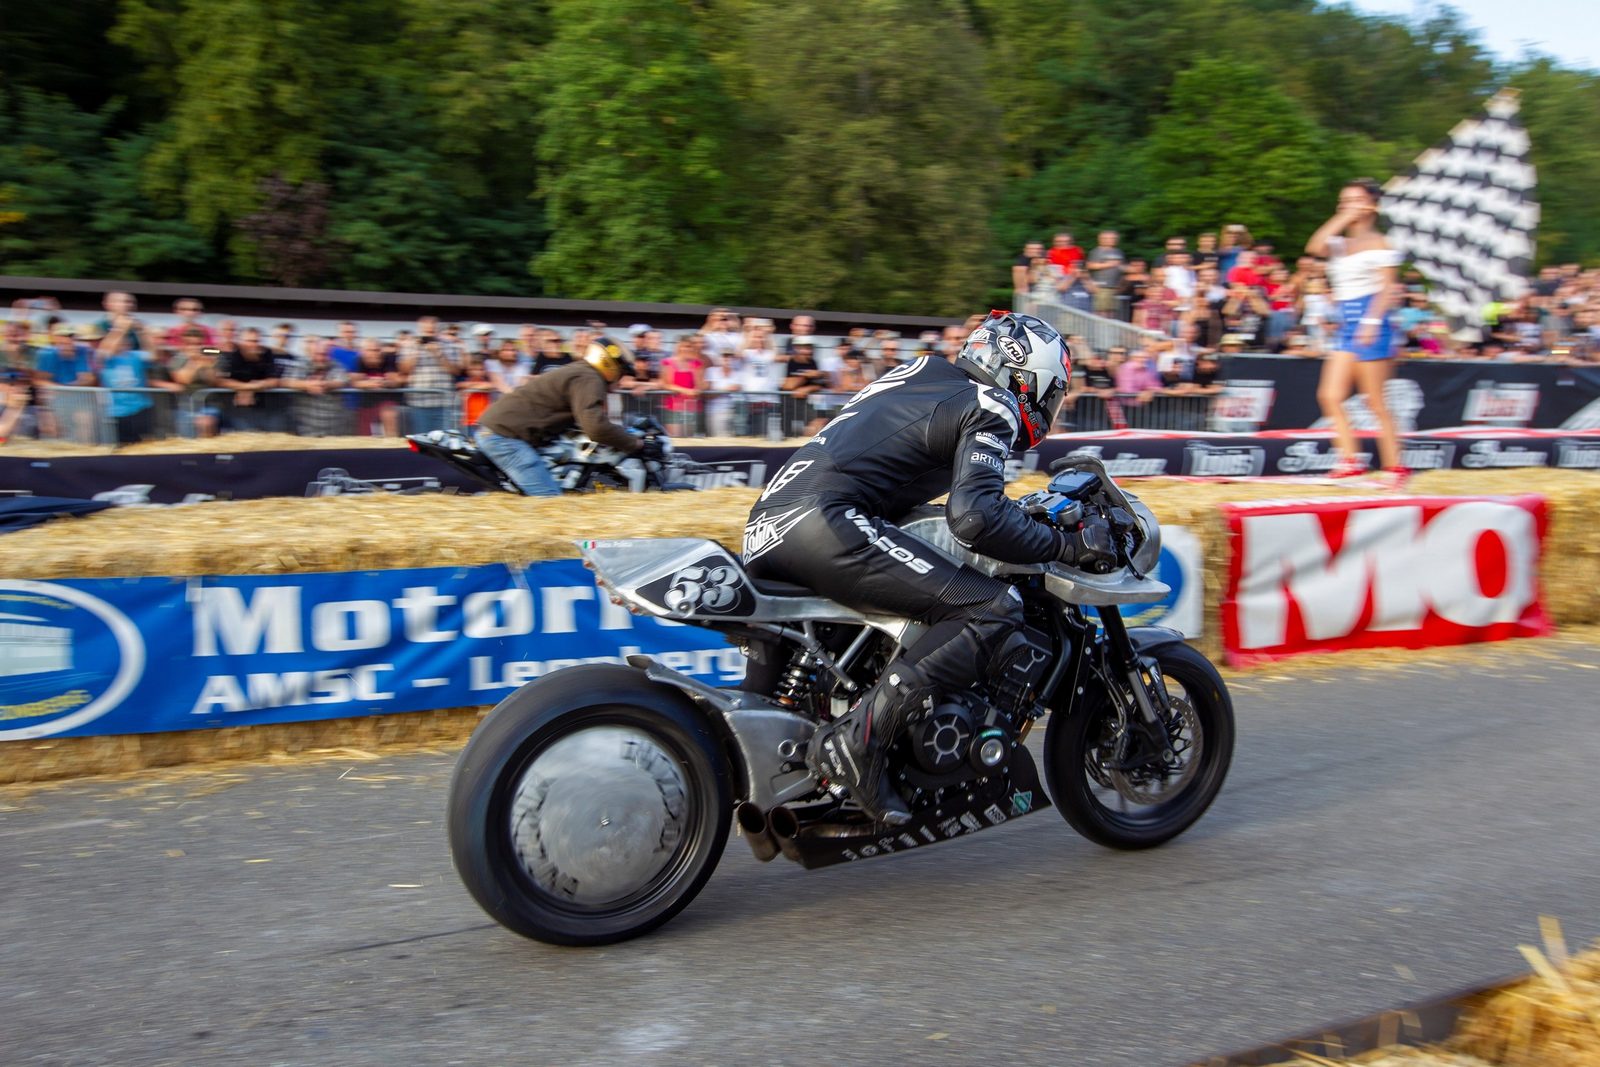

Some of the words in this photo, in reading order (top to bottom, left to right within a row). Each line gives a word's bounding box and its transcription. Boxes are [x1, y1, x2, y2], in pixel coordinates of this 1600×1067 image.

[1001, 338, 1023, 362] Arai
[664, 565, 744, 615] 53
[1236, 500, 1539, 650] MO
[193, 663, 395, 715] AMSC
